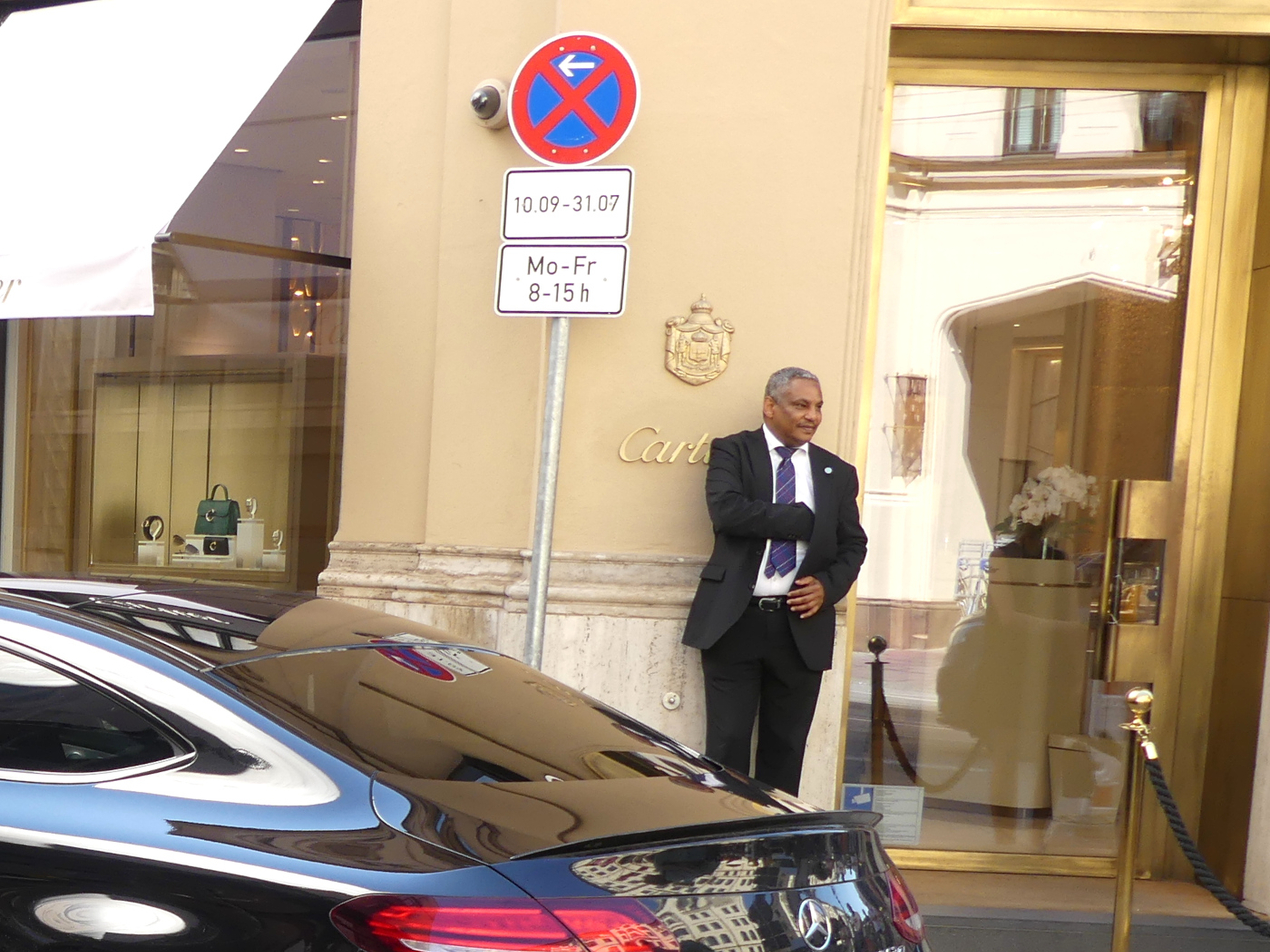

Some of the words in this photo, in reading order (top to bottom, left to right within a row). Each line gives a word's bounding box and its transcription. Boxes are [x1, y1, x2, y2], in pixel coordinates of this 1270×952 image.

[514, 195, 620, 213] 10.09-31.07
[527, 255, 597, 275] Mo-Fr
[529, 283, 574, 302] 8-15
[580, 283, 589, 302] h
